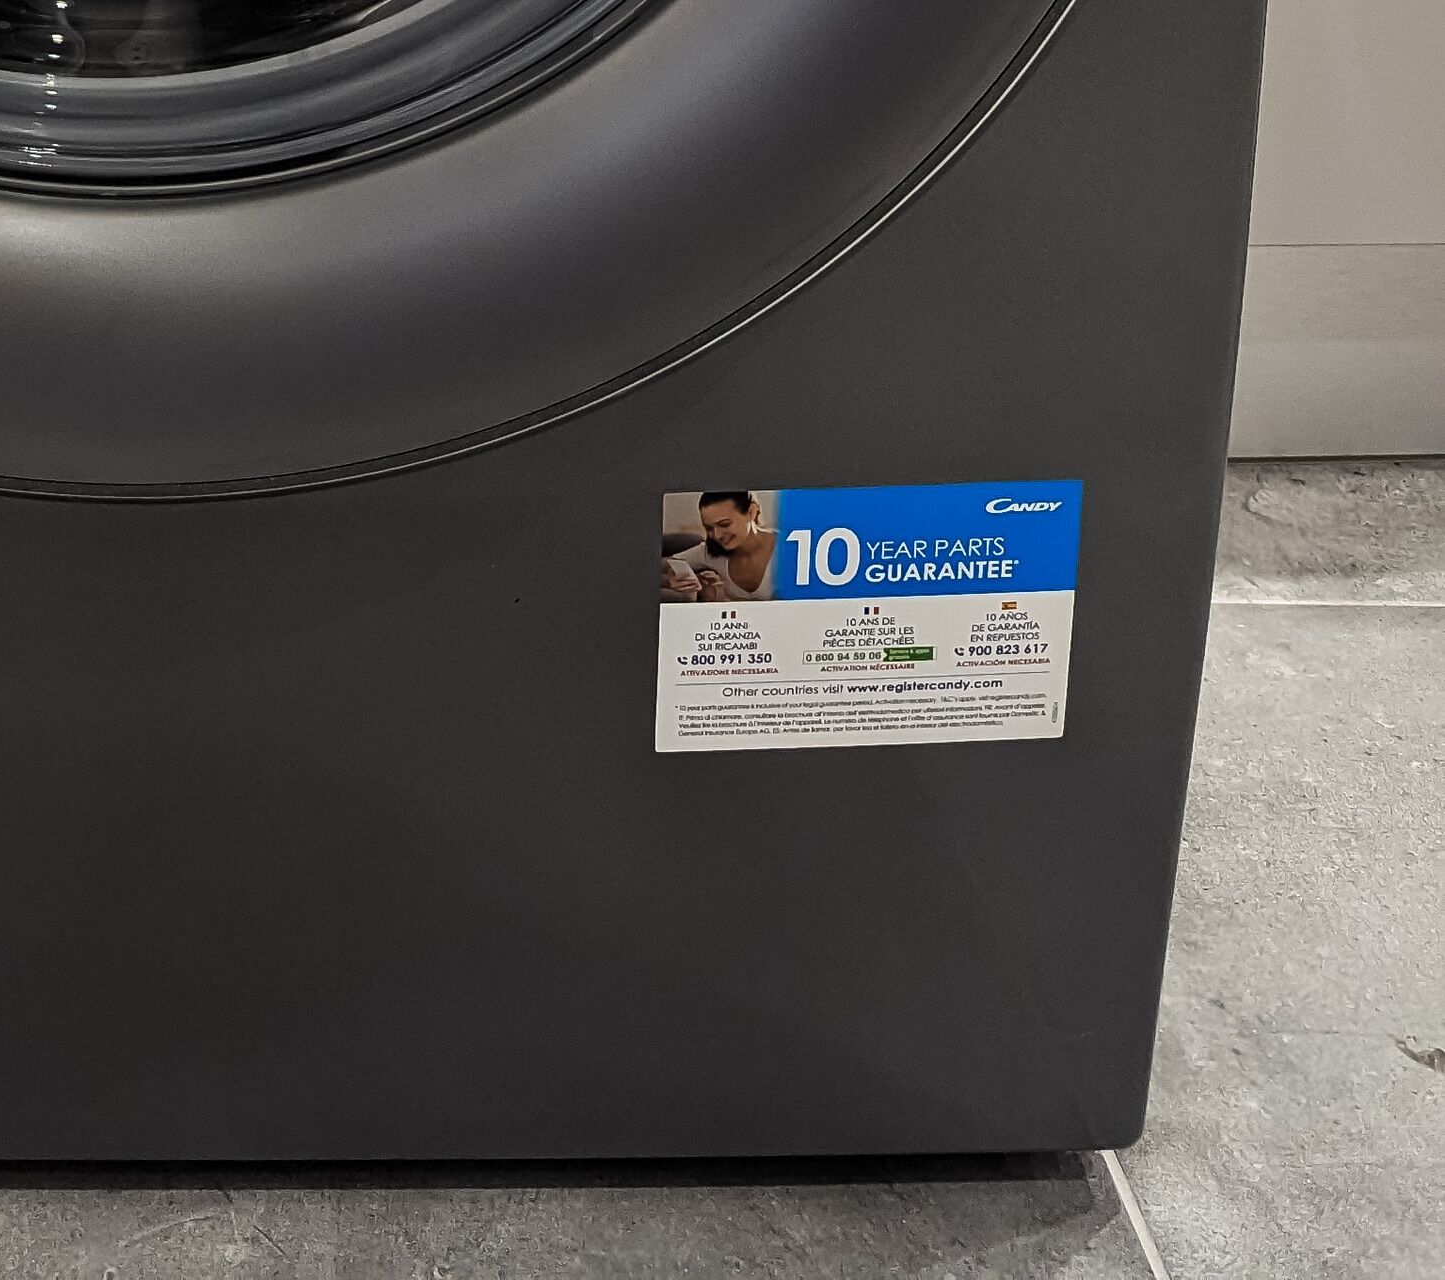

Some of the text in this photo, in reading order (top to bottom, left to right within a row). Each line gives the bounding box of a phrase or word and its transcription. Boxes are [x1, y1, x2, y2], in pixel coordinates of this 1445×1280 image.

[984, 498, 1063, 514] CANDY
[866, 536, 1005, 560] YEAR PARTS
[786, 527, 861, 586] 10
[845, 616, 896, 627] 10 ANS DE
[985, 611, 1029, 621] 10 AÑOS
[710, 621, 750, 631] 10 ANNI
[971, 622, 985, 632] DE
[694, 631, 762, 642] DI GARANZIA
[824, 626, 915, 638] GARANTIE SUR LES
[970, 631, 1040, 642] EN REPUESTOS
[697, 642, 758, 652] SUI RICAMBI
[968, 643, 1049, 656] 900 823 617
[690, 653, 773, 666] 800 991 350
[722, 679, 1003, 697] Other countries visit www.registercandy.com
